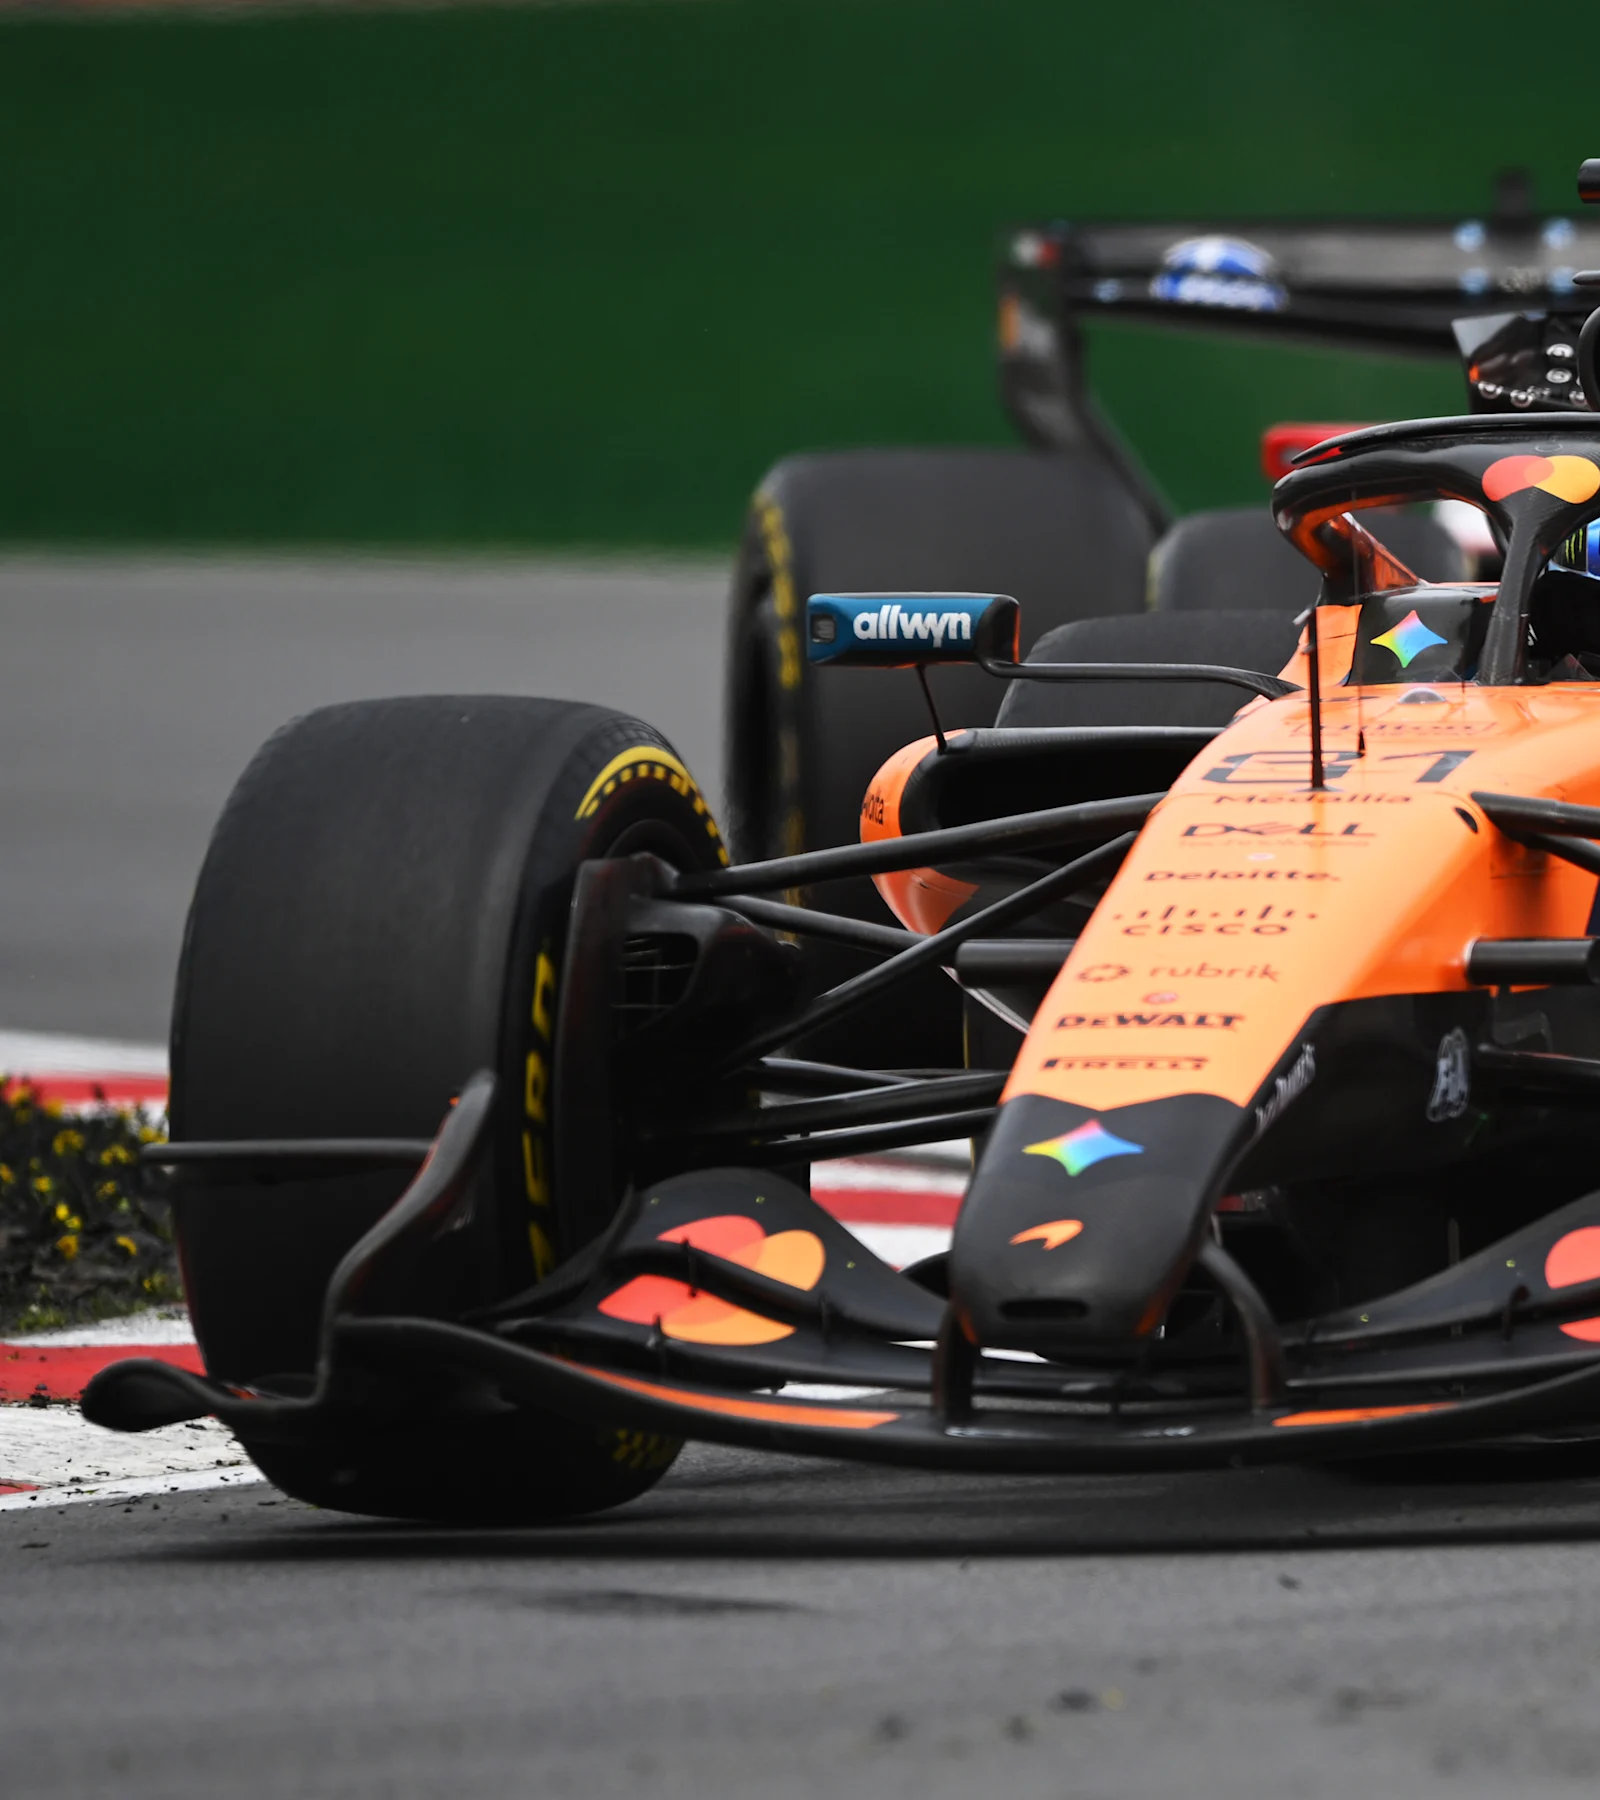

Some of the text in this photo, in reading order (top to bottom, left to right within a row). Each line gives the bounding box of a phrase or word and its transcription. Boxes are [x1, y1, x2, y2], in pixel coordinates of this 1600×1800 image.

[853, 604, 972, 648] allwyn
[1202, 749, 1476, 784] 81
[1213, 793, 1413, 805] Medallia
[1180, 821, 1377, 838] DELL
[1148, 961, 1281, 983] rubrik
[1039, 1055, 1210, 1071] PIRELLI
